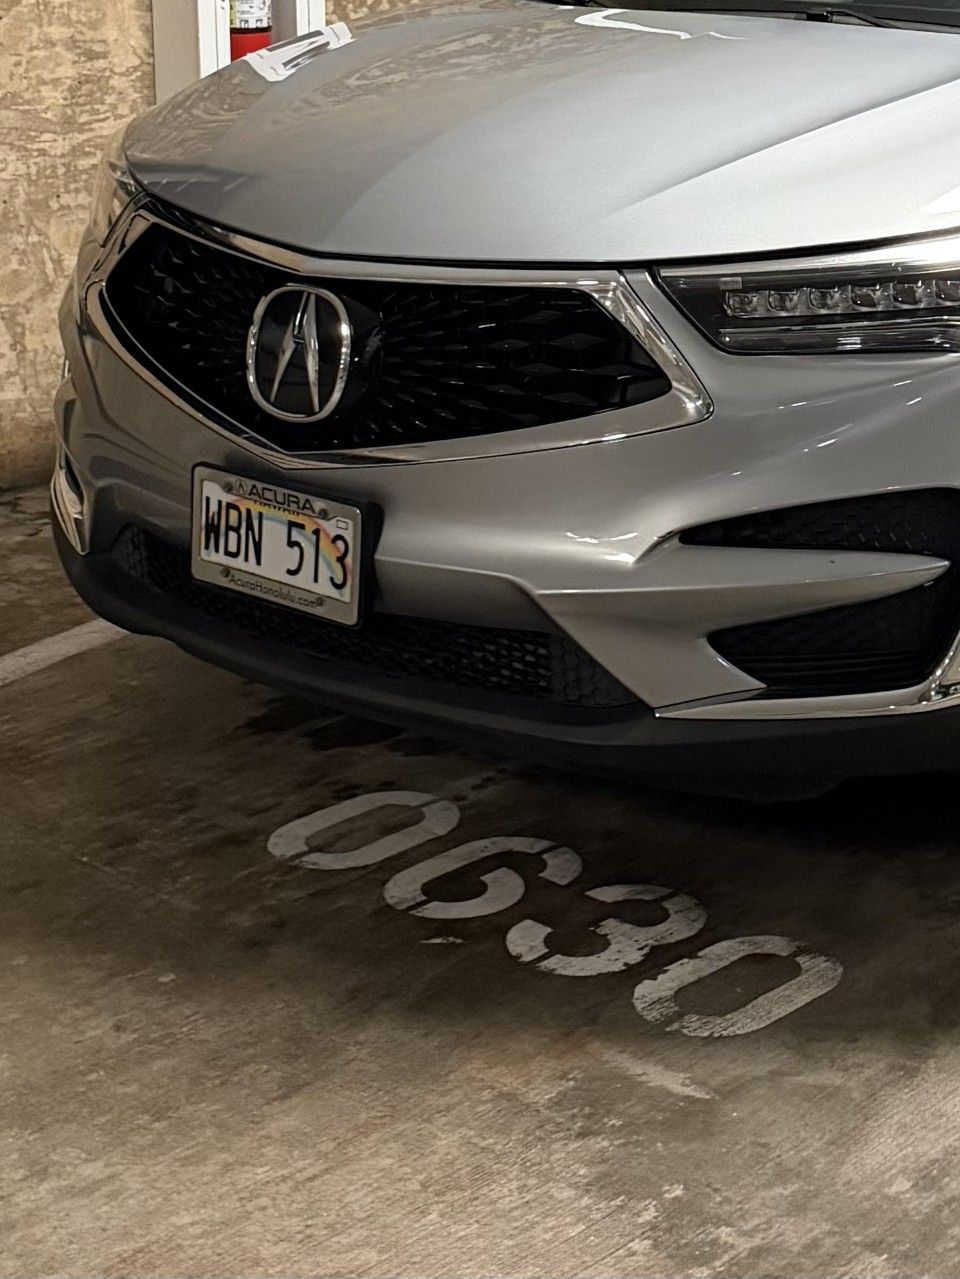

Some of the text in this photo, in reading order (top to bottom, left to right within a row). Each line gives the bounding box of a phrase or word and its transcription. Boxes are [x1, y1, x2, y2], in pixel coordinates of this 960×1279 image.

[204, 496, 349, 590] WBN 513
[249, 484, 316, 514] ACURA
[266, 790, 844, 1038] 0630
